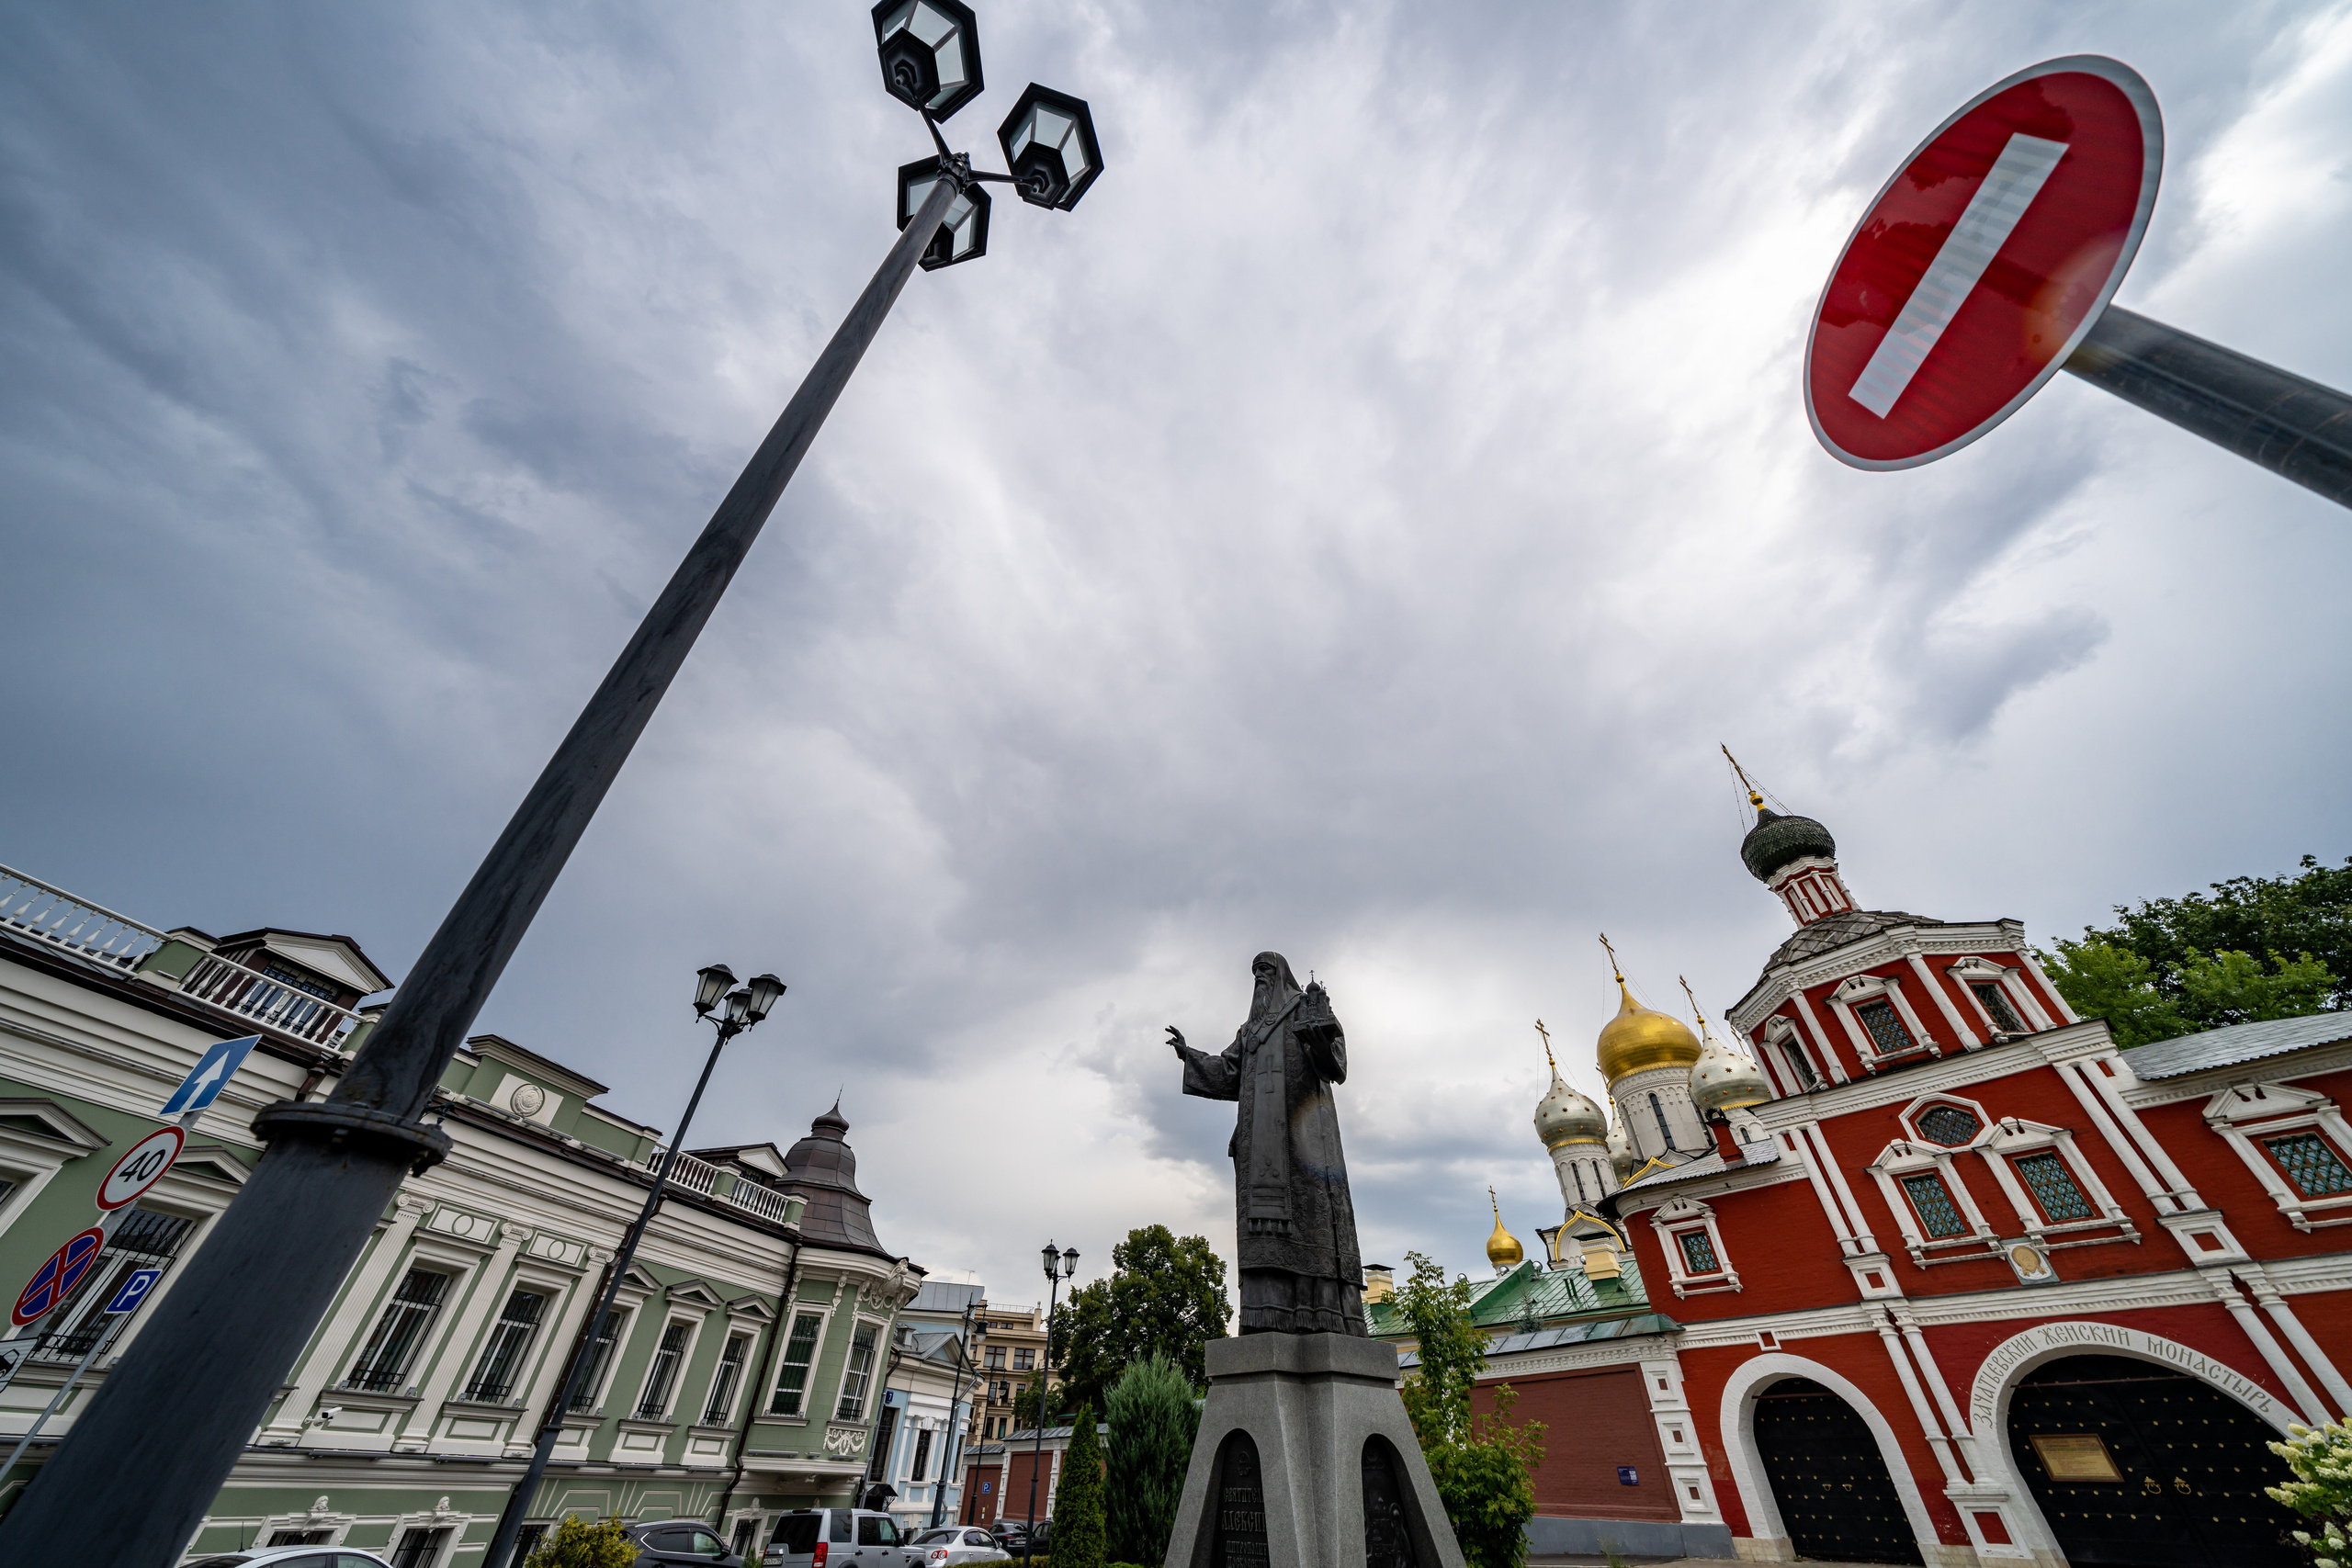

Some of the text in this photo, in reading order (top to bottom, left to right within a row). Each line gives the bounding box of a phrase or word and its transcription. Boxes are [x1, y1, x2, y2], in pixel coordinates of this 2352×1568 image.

[118, 1149, 165, 1182] 40
[117, 1275, 150, 1307] P
[1973, 1325, 2273, 1429] ЗАЧАТЬЕВСКИЙ ЖЕНСКИЙ МОНАСТЫРЬ
